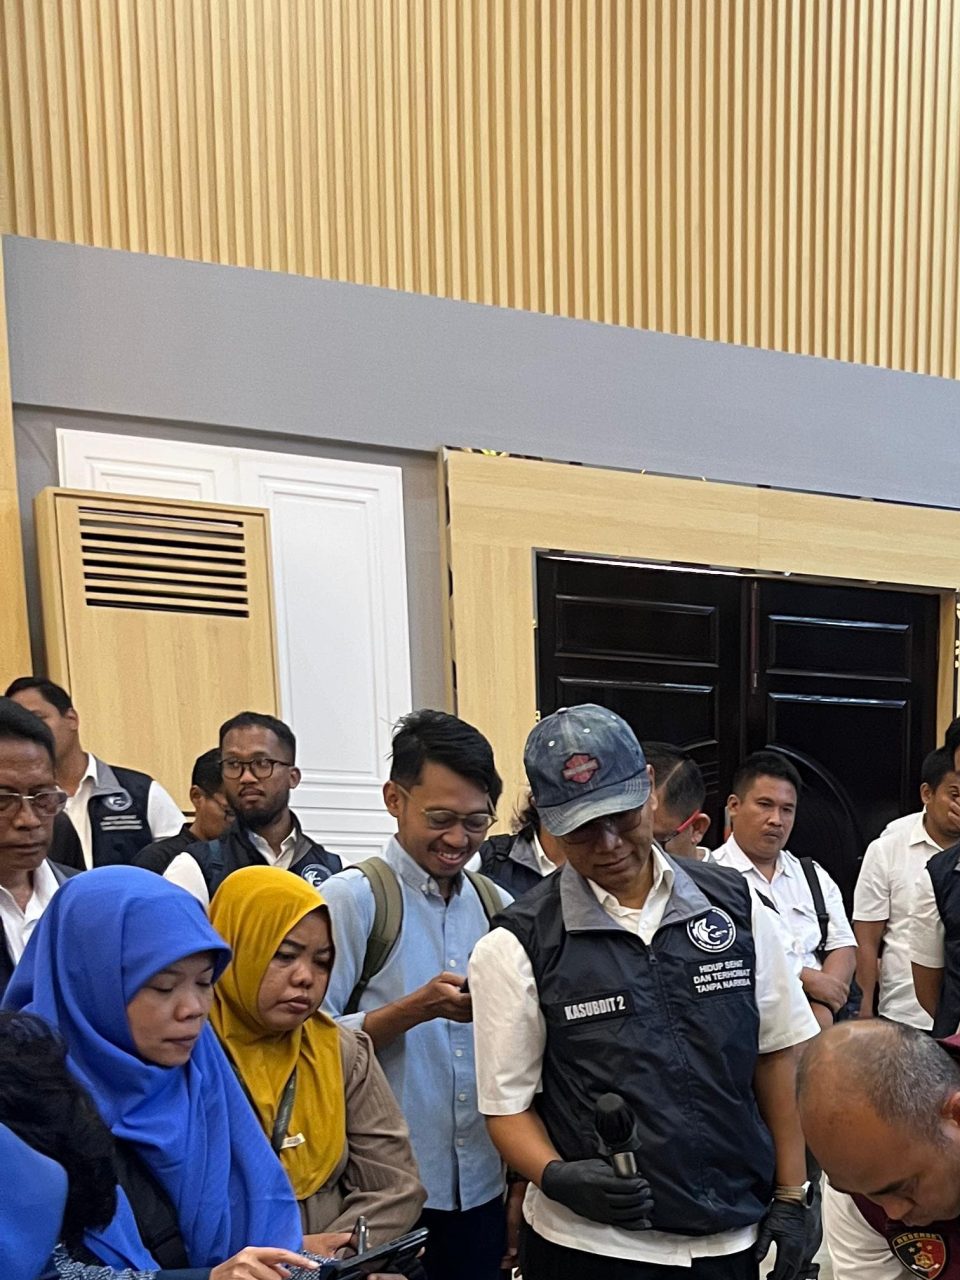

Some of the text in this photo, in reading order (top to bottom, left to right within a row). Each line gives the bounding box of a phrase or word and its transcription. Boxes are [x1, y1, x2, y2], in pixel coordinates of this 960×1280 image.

[699, 962, 723, 974] HIDUP
[692, 973, 712, 984] DAN
[695, 982, 722, 994] TANPA
[564, 995, 626, 1021] KASUBDIT 2
